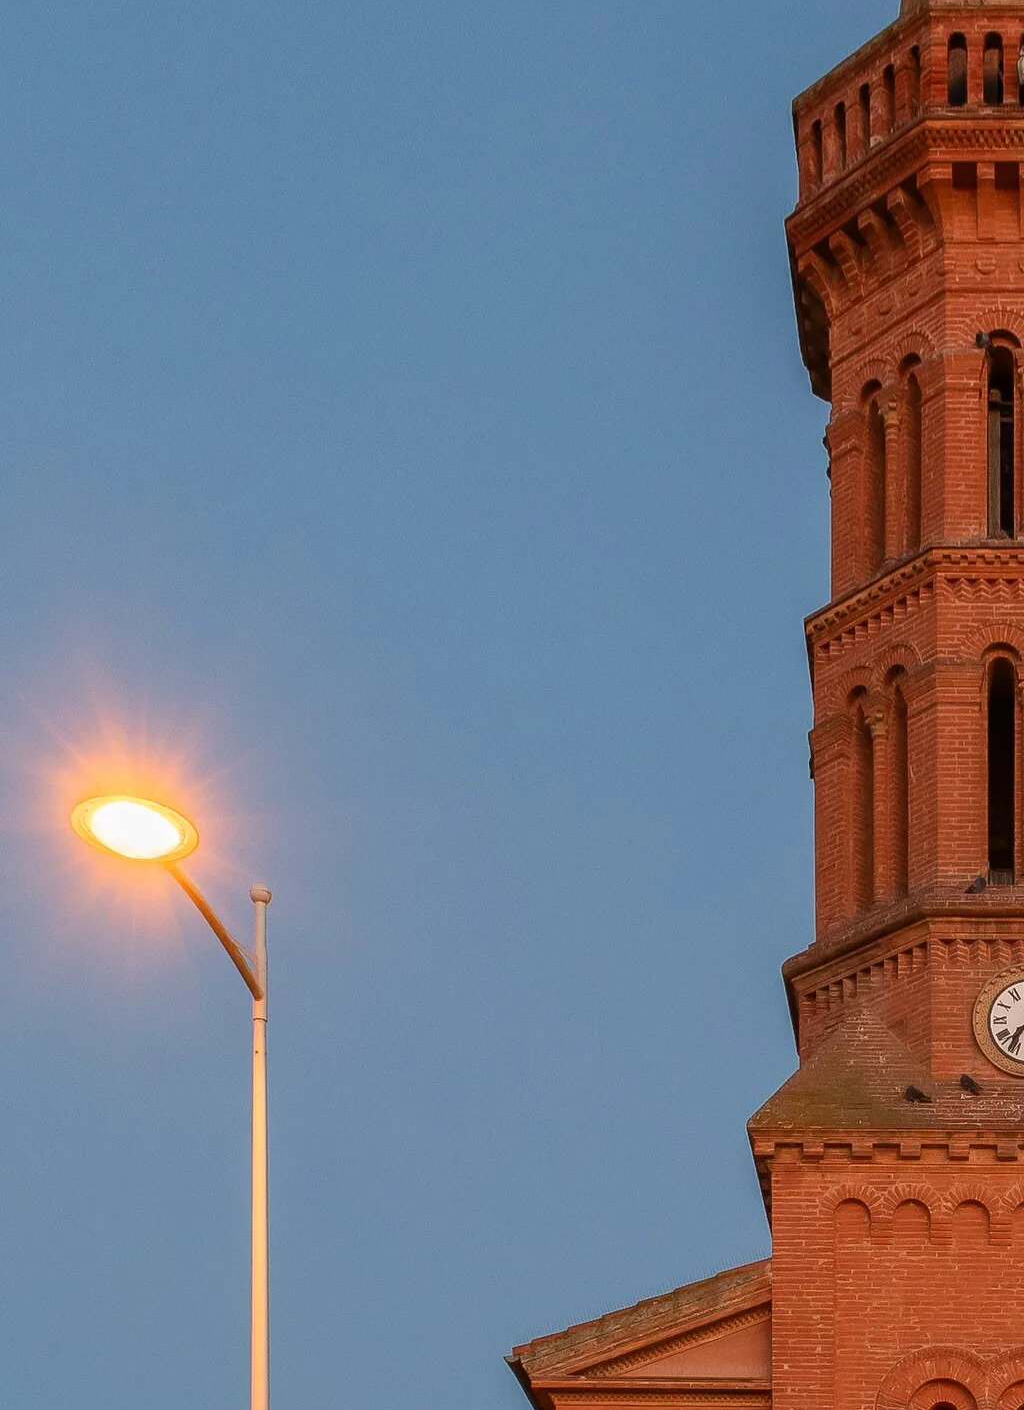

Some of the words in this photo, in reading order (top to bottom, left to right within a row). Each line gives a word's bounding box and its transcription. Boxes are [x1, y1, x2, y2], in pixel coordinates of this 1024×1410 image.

[1008, 988, 1021, 1003] XI
[997, 1000, 1011, 1012] X
[993, 1015, 1007, 1024] IX
